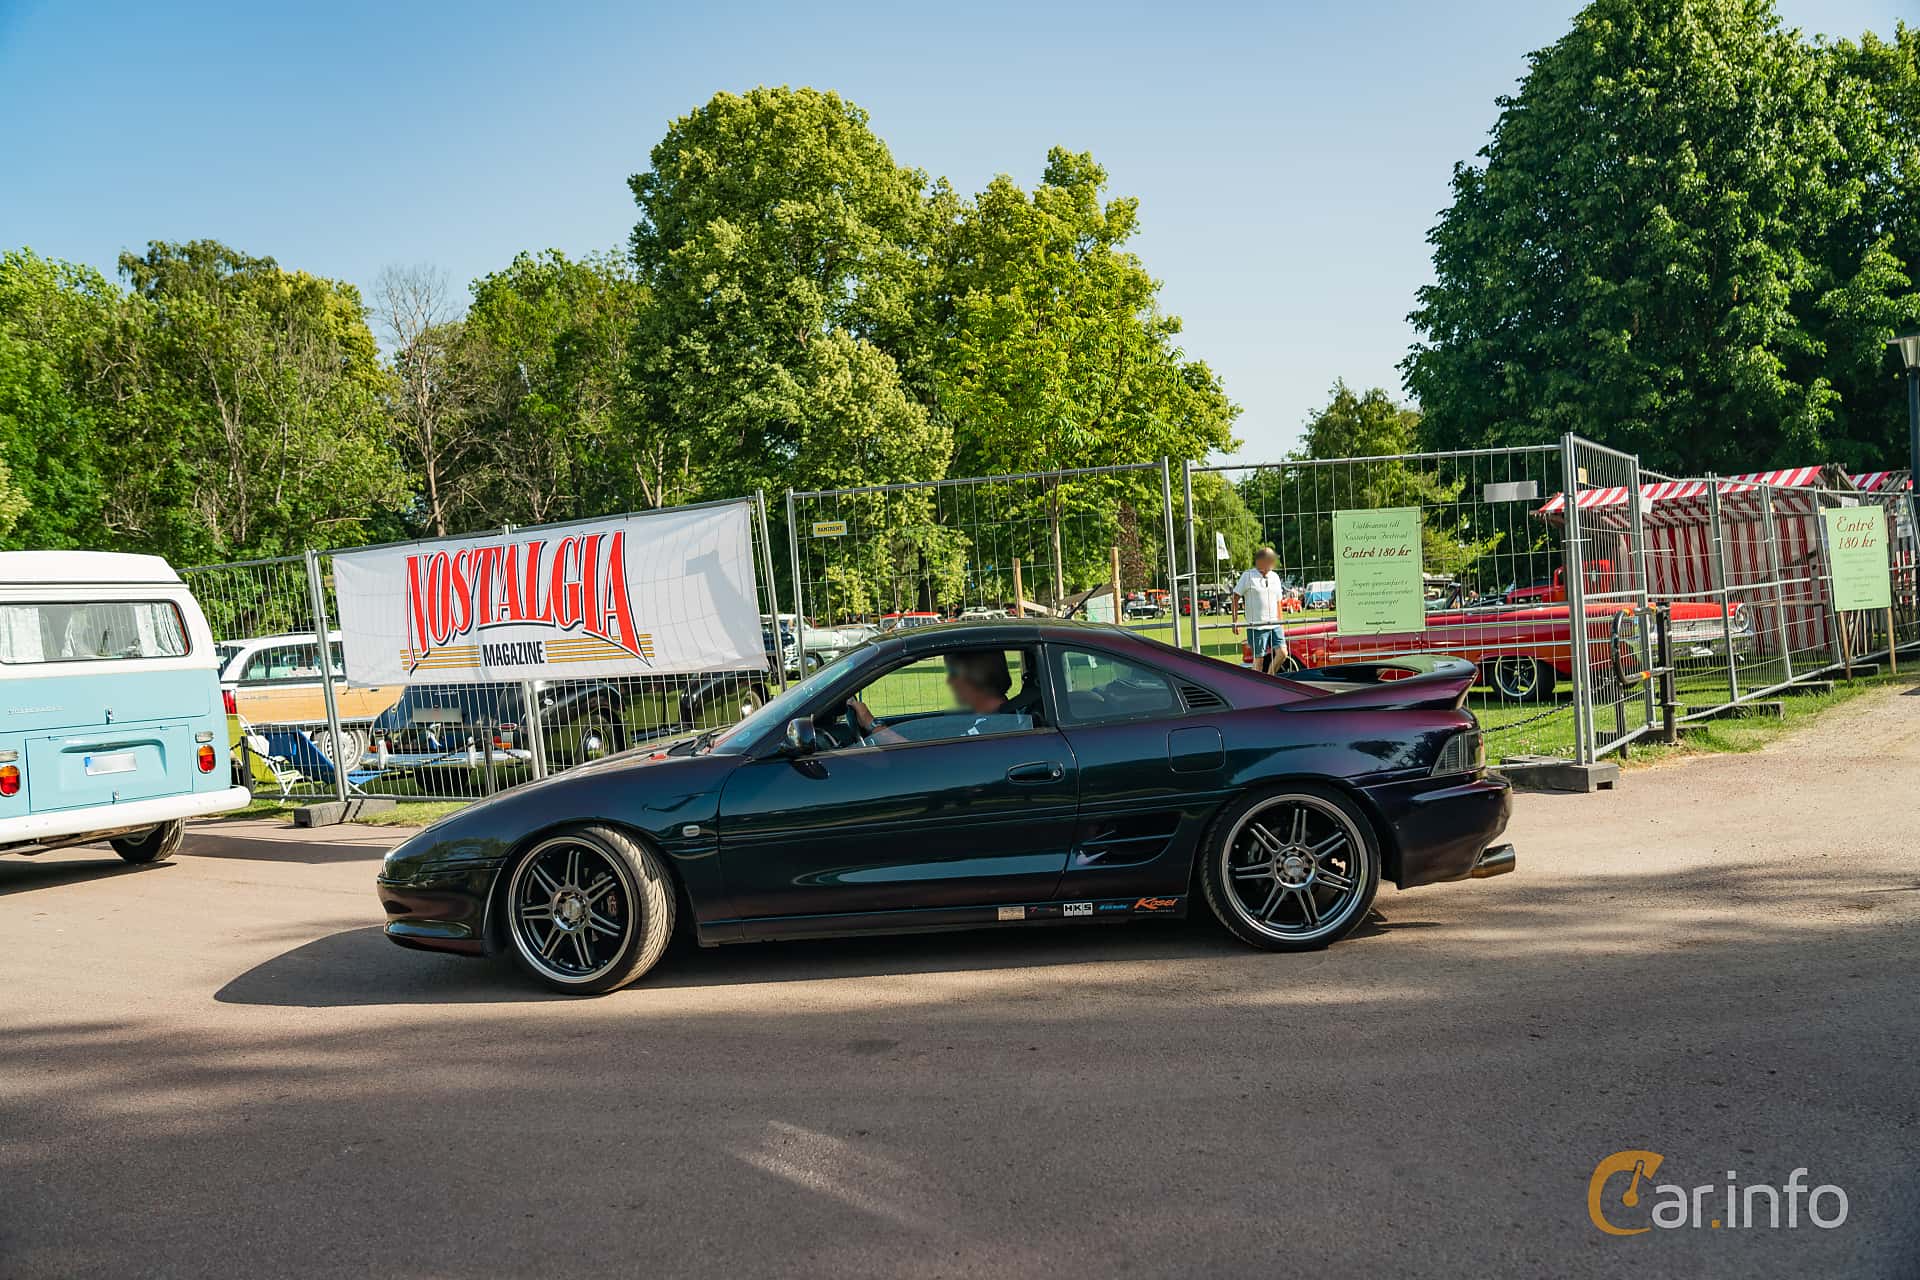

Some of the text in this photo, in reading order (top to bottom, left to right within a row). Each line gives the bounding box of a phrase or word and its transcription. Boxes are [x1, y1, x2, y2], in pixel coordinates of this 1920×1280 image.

[1836, 515, 1874, 532] Entré
[1838, 532, 1877, 550] 180 kr
[1342, 544, 1412, 559] Entré 180 kr
[406, 530, 652, 677] NOSTALGIA
[482, 640, 546, 667] MAGAZINE
[1064, 903, 1092, 912] HKS
